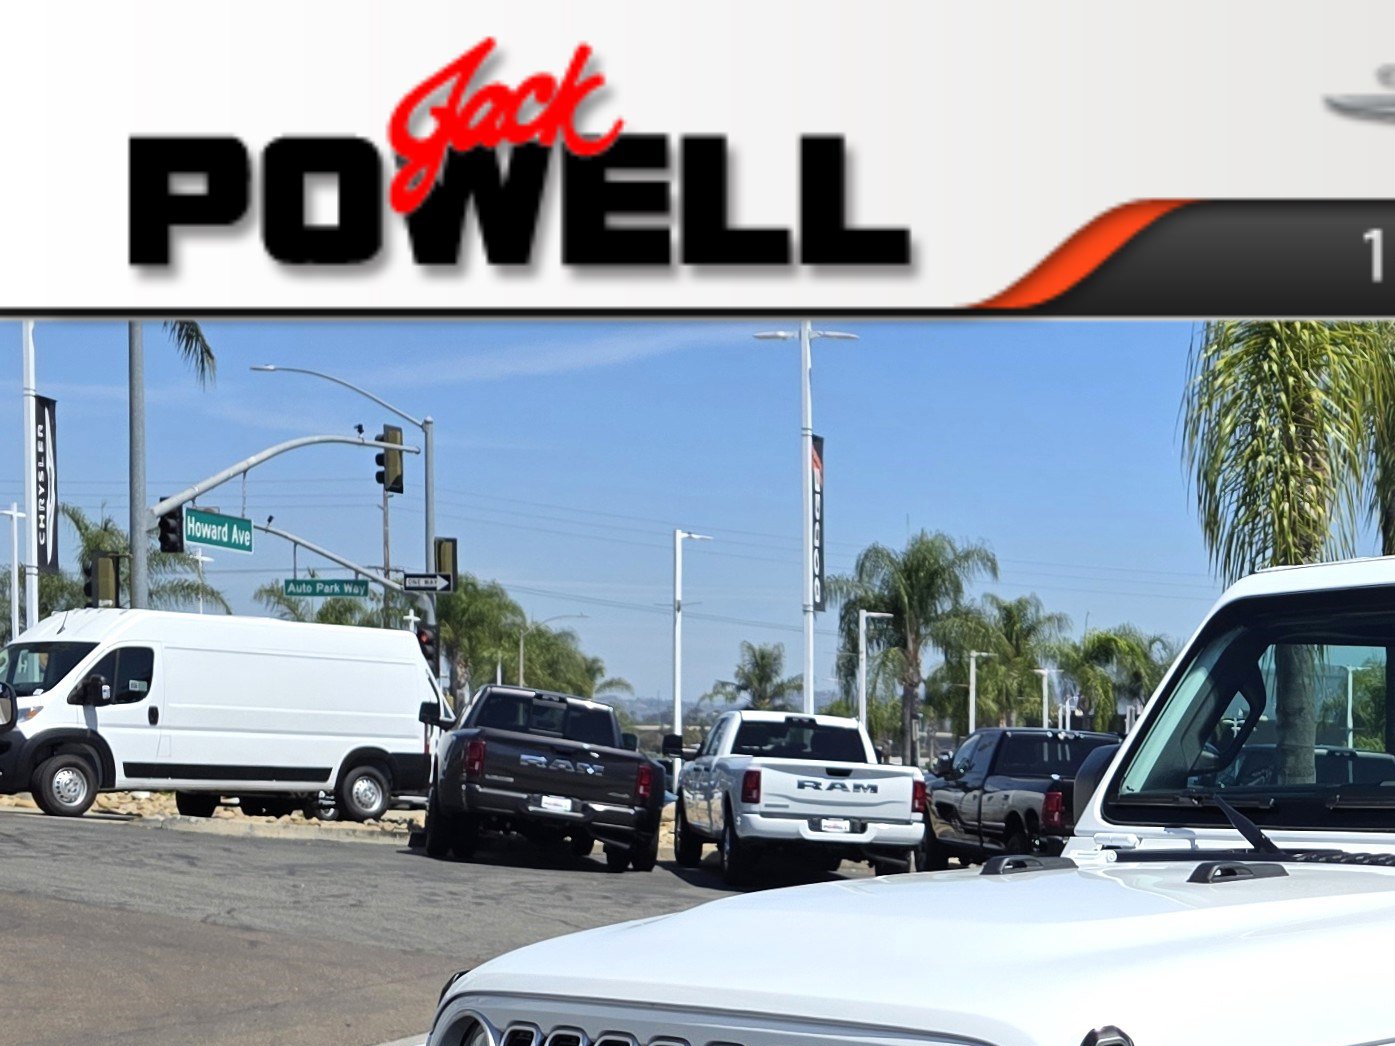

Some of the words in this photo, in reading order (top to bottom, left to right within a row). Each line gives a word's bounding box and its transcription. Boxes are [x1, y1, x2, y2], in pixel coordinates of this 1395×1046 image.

[37, 424, 46, 546] CHRYSLER
[187, 515, 229, 542] Howard
[231, 524, 251, 547] Ave
[287, 582, 312, 594] Auto
[316, 582, 341, 594] Park
[344, 582, 366, 596] Way
[519, 753, 605, 777] RAM
[796, 779, 879, 794] RAM
